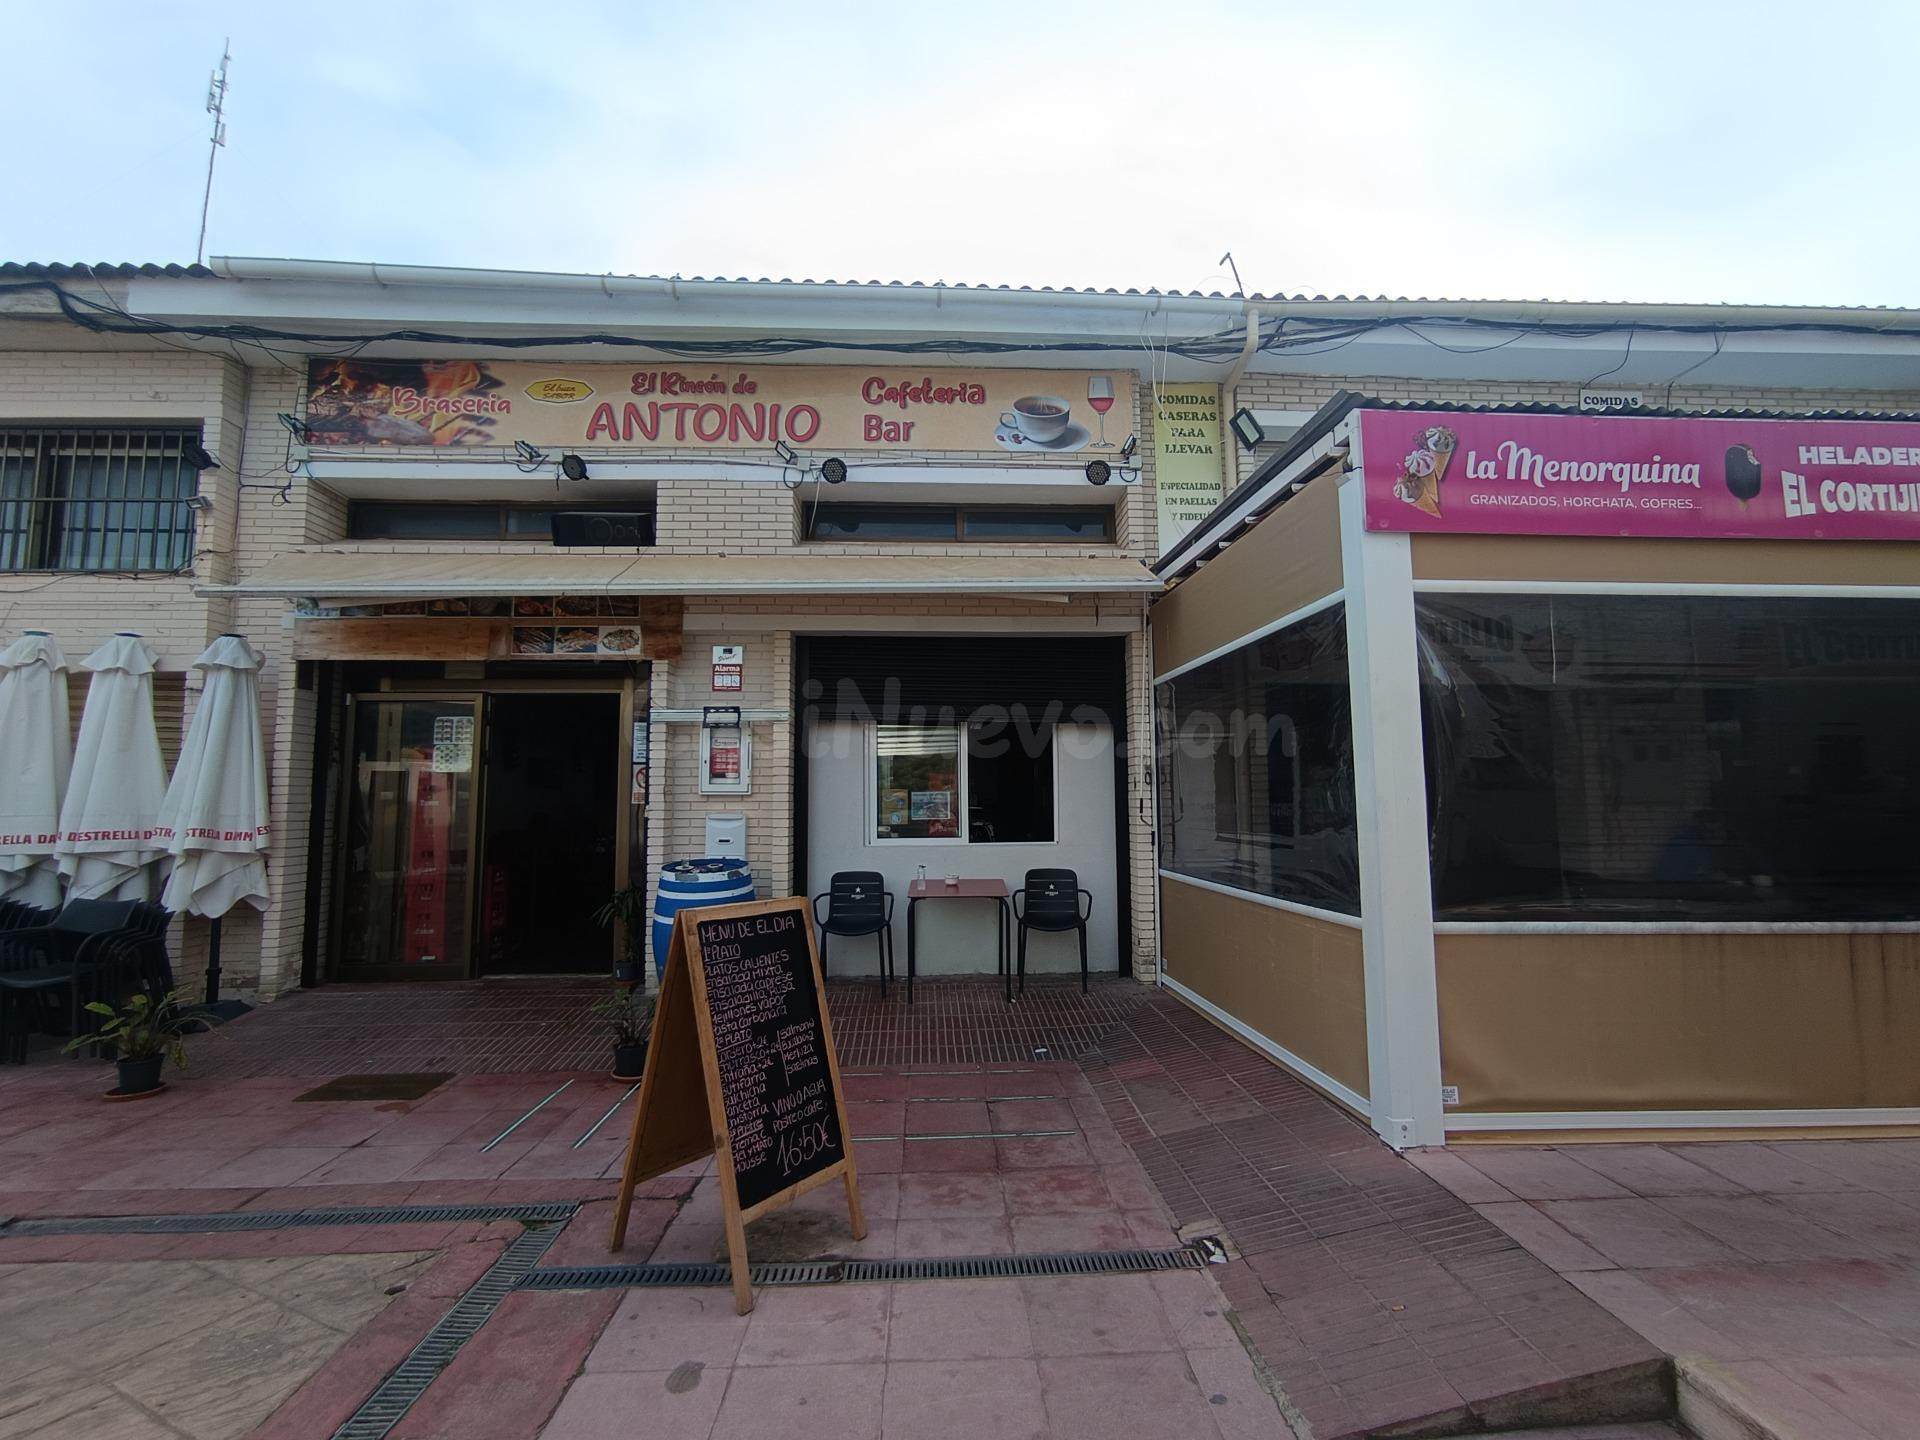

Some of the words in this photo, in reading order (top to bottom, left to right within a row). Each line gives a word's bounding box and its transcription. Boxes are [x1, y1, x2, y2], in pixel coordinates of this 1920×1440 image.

[631, 372, 657, 395] El
[660, 371, 727, 396] Rincón
[732, 373, 757, 395] de
[393, 386, 513, 416] Braseria
[1158, 394, 1216, 405] COMIDAS
[1583, 396, 1639, 405] COMIDAS
[585, 400, 820, 442] ANTONIO
[1158, 411, 1217, 422] CASERAS
[863, 414, 914, 441] Bar
[1171, 427, 1205, 438] PARA
[1164, 444, 1213, 454] LLEVAR
[1798, 446, 1920, 466] HELADER
[1497, 440, 1701, 493] Menorquina
[1179, 498, 1218, 506] PAELLAS
[1470, 494, 1560, 508] GRANIZADOS,
[1563, 496, 1637, 509] HORCHATA,
[1640, 498, 1703, 509] GOFRES...
[1781, 470, 1817, 518] EL
[1179, 510, 1210, 521] FIDEU
[738, 921, 755, 938] DE
